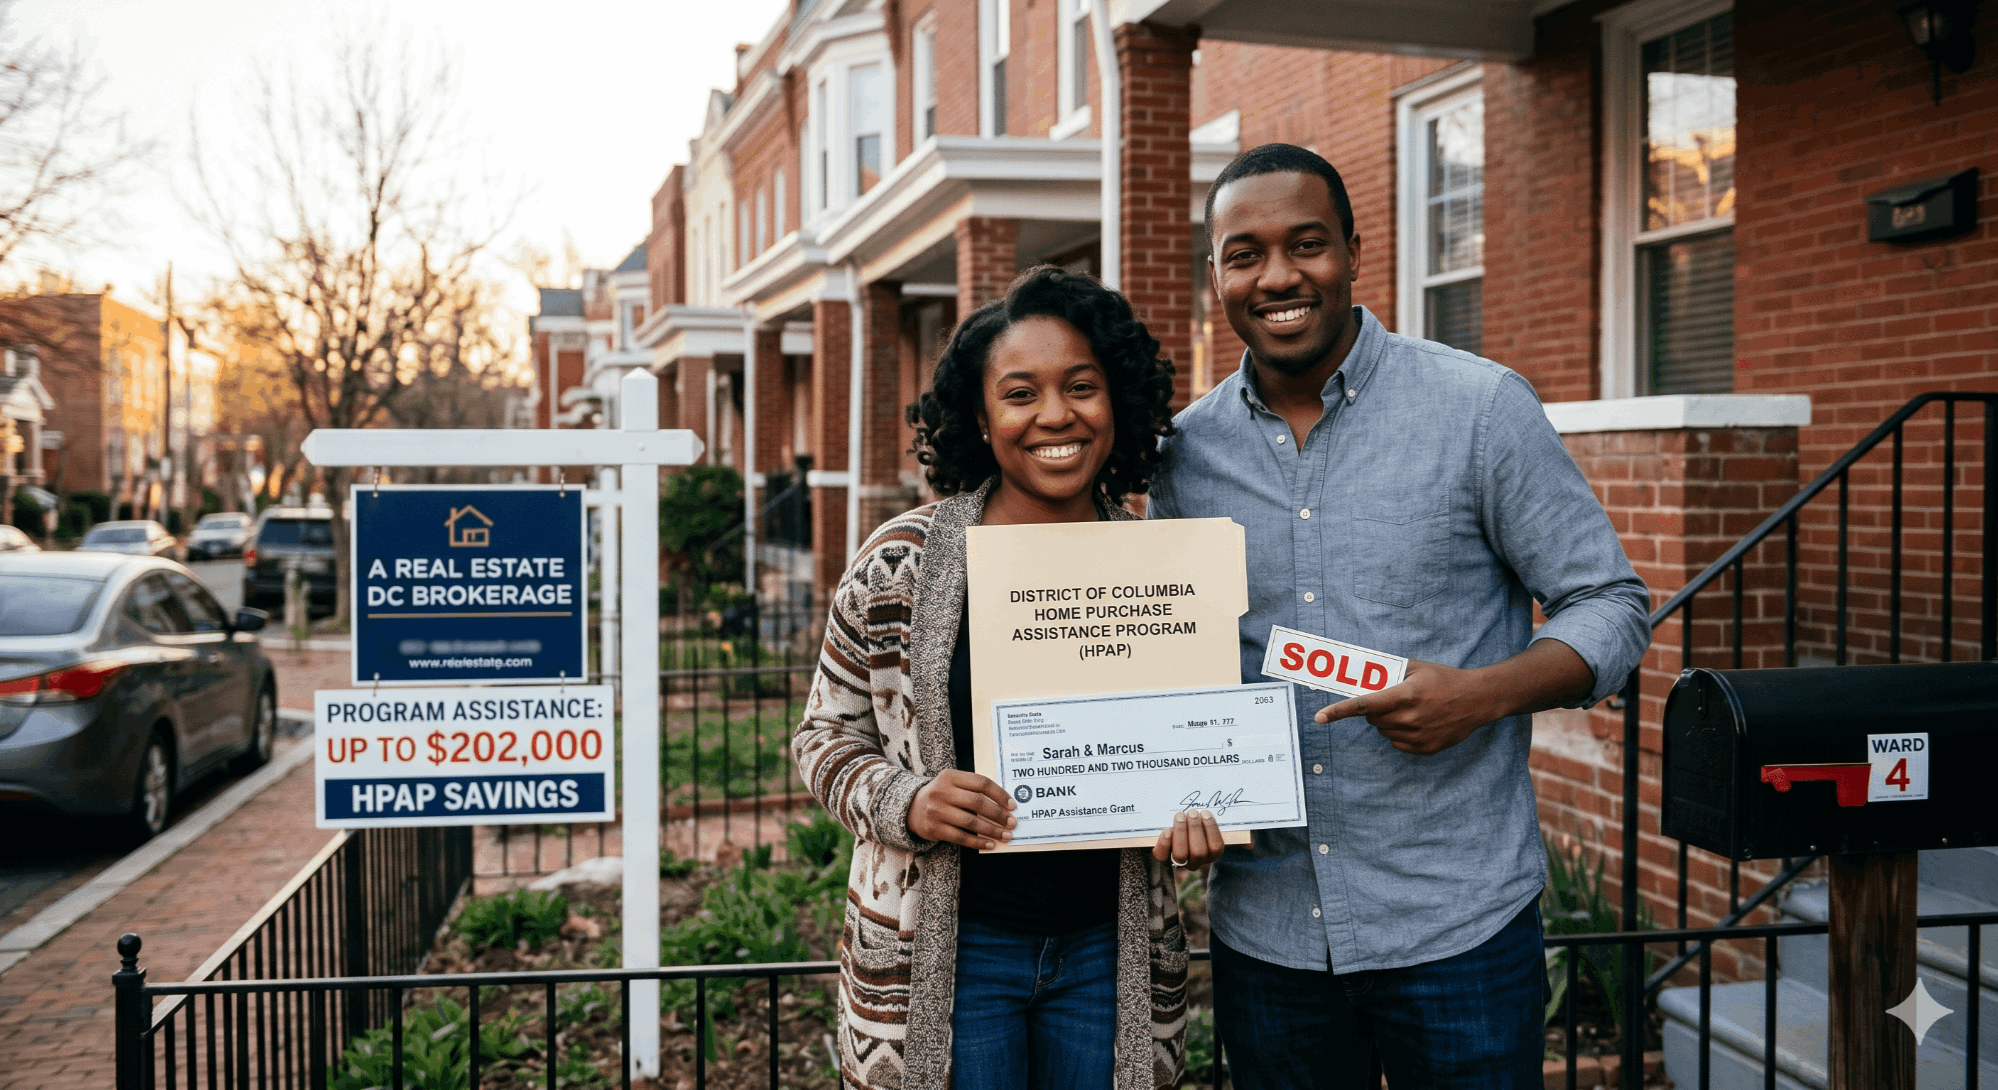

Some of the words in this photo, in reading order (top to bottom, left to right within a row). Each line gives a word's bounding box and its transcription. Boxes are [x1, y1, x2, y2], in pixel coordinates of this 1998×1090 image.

[368, 558, 388, 579] A
[395, 557, 464, 579] REAL
[470, 557, 565, 579] ESTATE
[367, 585, 405, 607] DC
[412, 584, 573, 606] BROKERAGE
[1010, 588, 1082, 603] DISTRICT
[1086, 586, 1107, 600] OF
[1111, 583, 1196, 599] COLUMBIA
[1034, 607, 1081, 621] HOME
[1086, 603, 1173, 619] PURCHASE
[1012, 624, 1111, 641] ASSISTANCE
[1116, 621, 1197, 637] PROGRAM
[1079, 643, 1132, 661] (HPAP)
[1279, 642, 1389, 691] SOLD
[327, 701, 445, 723] PROGRAM
[452, 698, 603, 721] ASSISTANCE:
[1254, 696, 1274, 705] 2063
[327, 737, 368, 764] UP
[377, 736, 417, 763] TO
[427, 729, 603, 767] $202,000
[1042, 745, 1080, 760] Sarah
[1083, 743, 1094, 757] &
[1097, 743, 1145, 756] Marcus
[1871, 737, 1925, 753] WARD
[1012, 767, 1035, 778] TWO
[1037, 764, 1085, 776] HUNDRED
[1088, 762, 1109, 773] AND
[1111, 760, 1134, 771] TWO
[1136, 757, 1191, 769] THOUSAND
[1193, 754, 1240, 766] DOLLARS
[1885, 757, 1911, 792] 4
[352, 783, 437, 813] HPAP
[443, 778, 580, 811] SAVINGS
[1035, 785, 1077, 798] BANK
[1031, 808, 1057, 819] HPAP
[1058, 806, 1108, 817] Assistance
[1109, 803, 1135, 814] Grant
